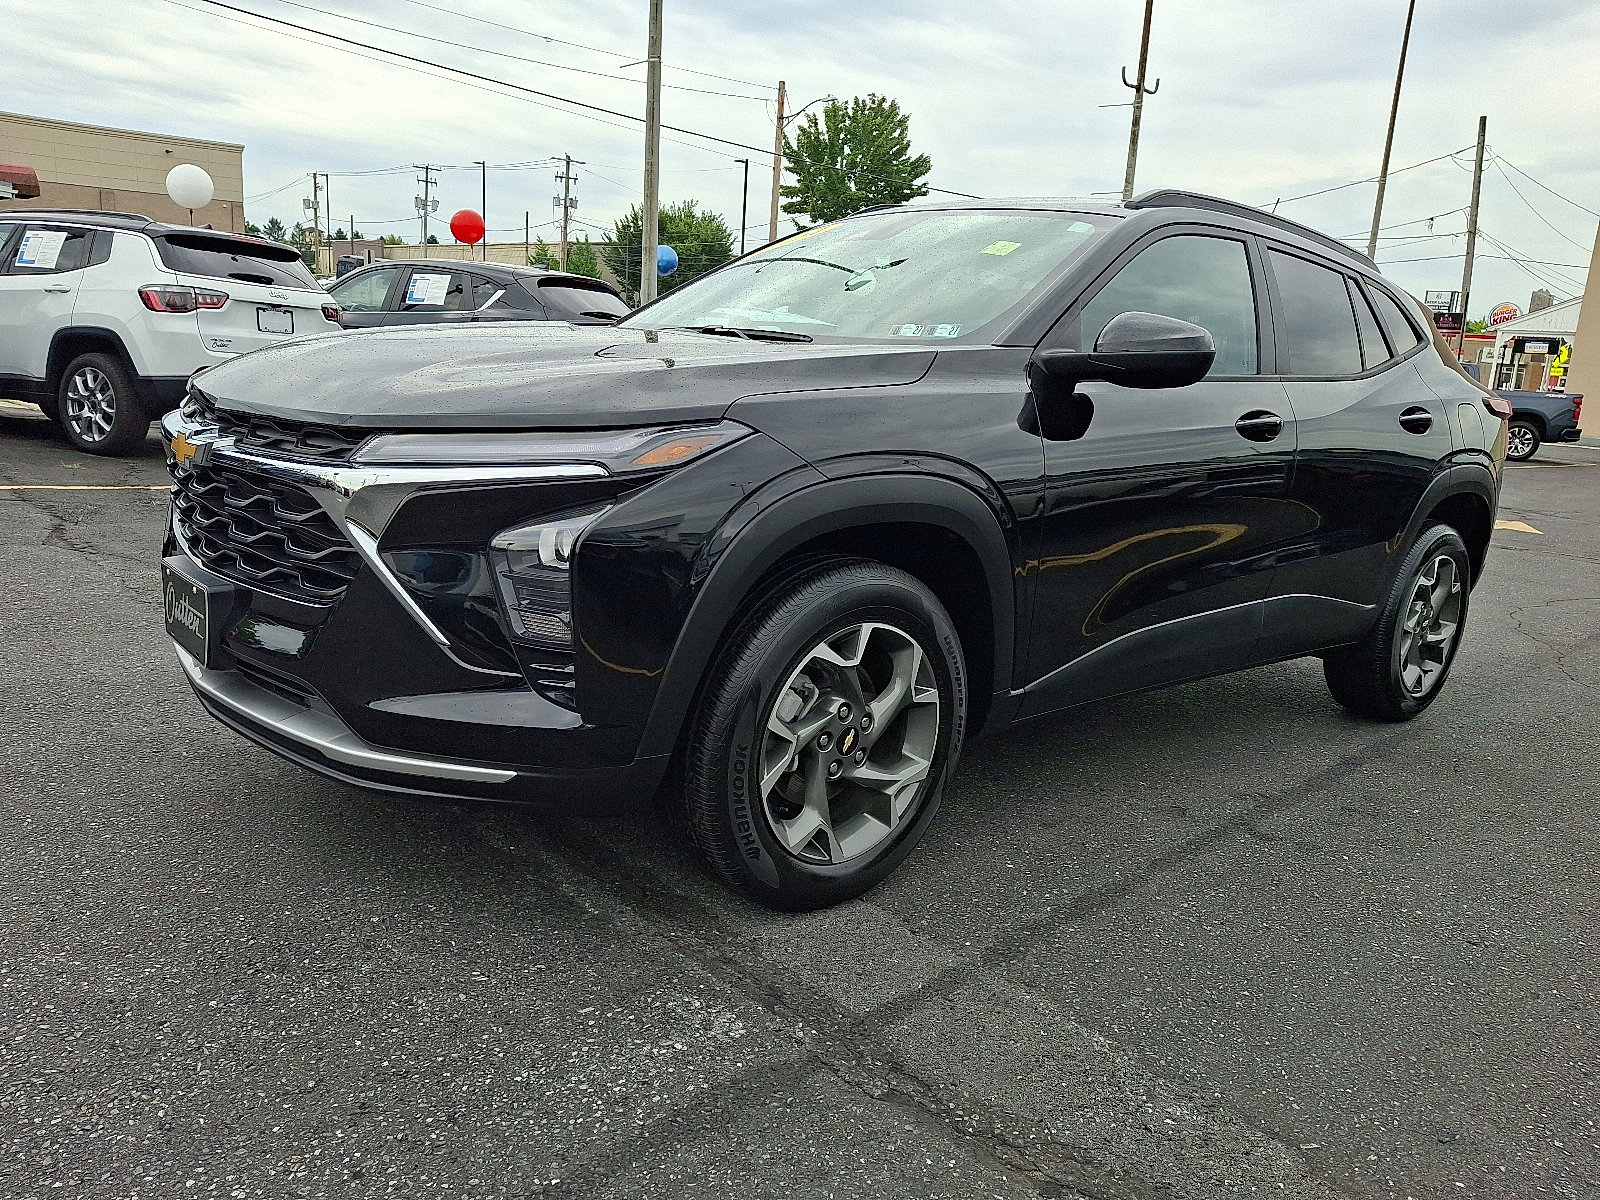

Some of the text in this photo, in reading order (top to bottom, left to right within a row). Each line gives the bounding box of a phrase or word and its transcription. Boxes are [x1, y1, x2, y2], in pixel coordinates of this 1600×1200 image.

[1492, 308, 1518, 318] BURGER
[912, 325, 924, 335] 27
[165, 581, 204, 640] Outten
